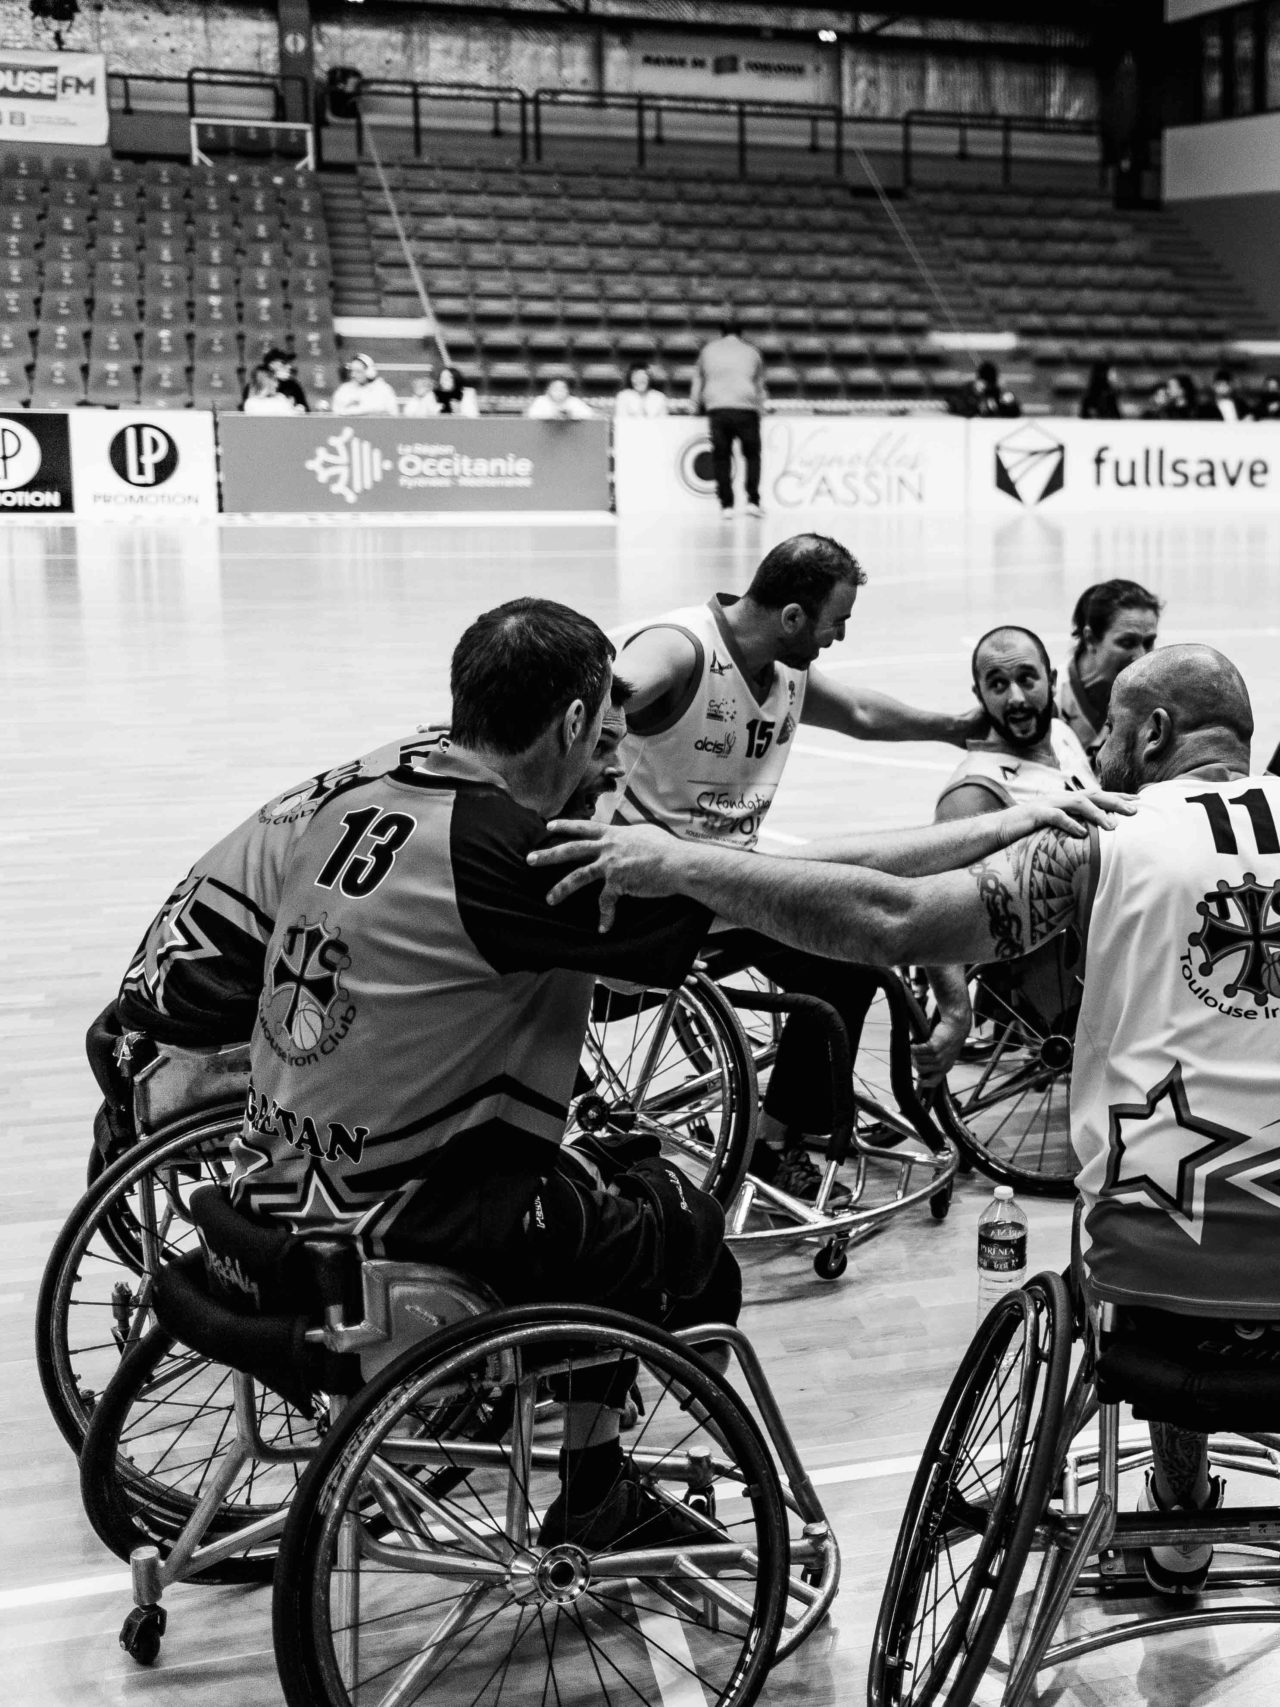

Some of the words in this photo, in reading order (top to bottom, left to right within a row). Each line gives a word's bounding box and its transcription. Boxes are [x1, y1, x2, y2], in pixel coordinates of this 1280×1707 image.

[0, 70, 57, 94] USE
[61, 75, 96, 95] FM
[125, 426, 169, 484] LP
[398, 452, 535, 477] Occitanie
[1094, 446, 1269, 488] fullsave
[0, 490, 61, 507] OTION
[93, 494, 200, 505] PROMOTION
[773, 470, 924, 507] CASSIN
[745, 719, 776, 759] 15
[273, 808, 314, 825] Club
[1185, 788, 1280, 855] 11
[314, 804, 417, 899] 13
[1180, 947, 1258, 1020] Toulouse
[320, 1005, 357, 1056] Club
